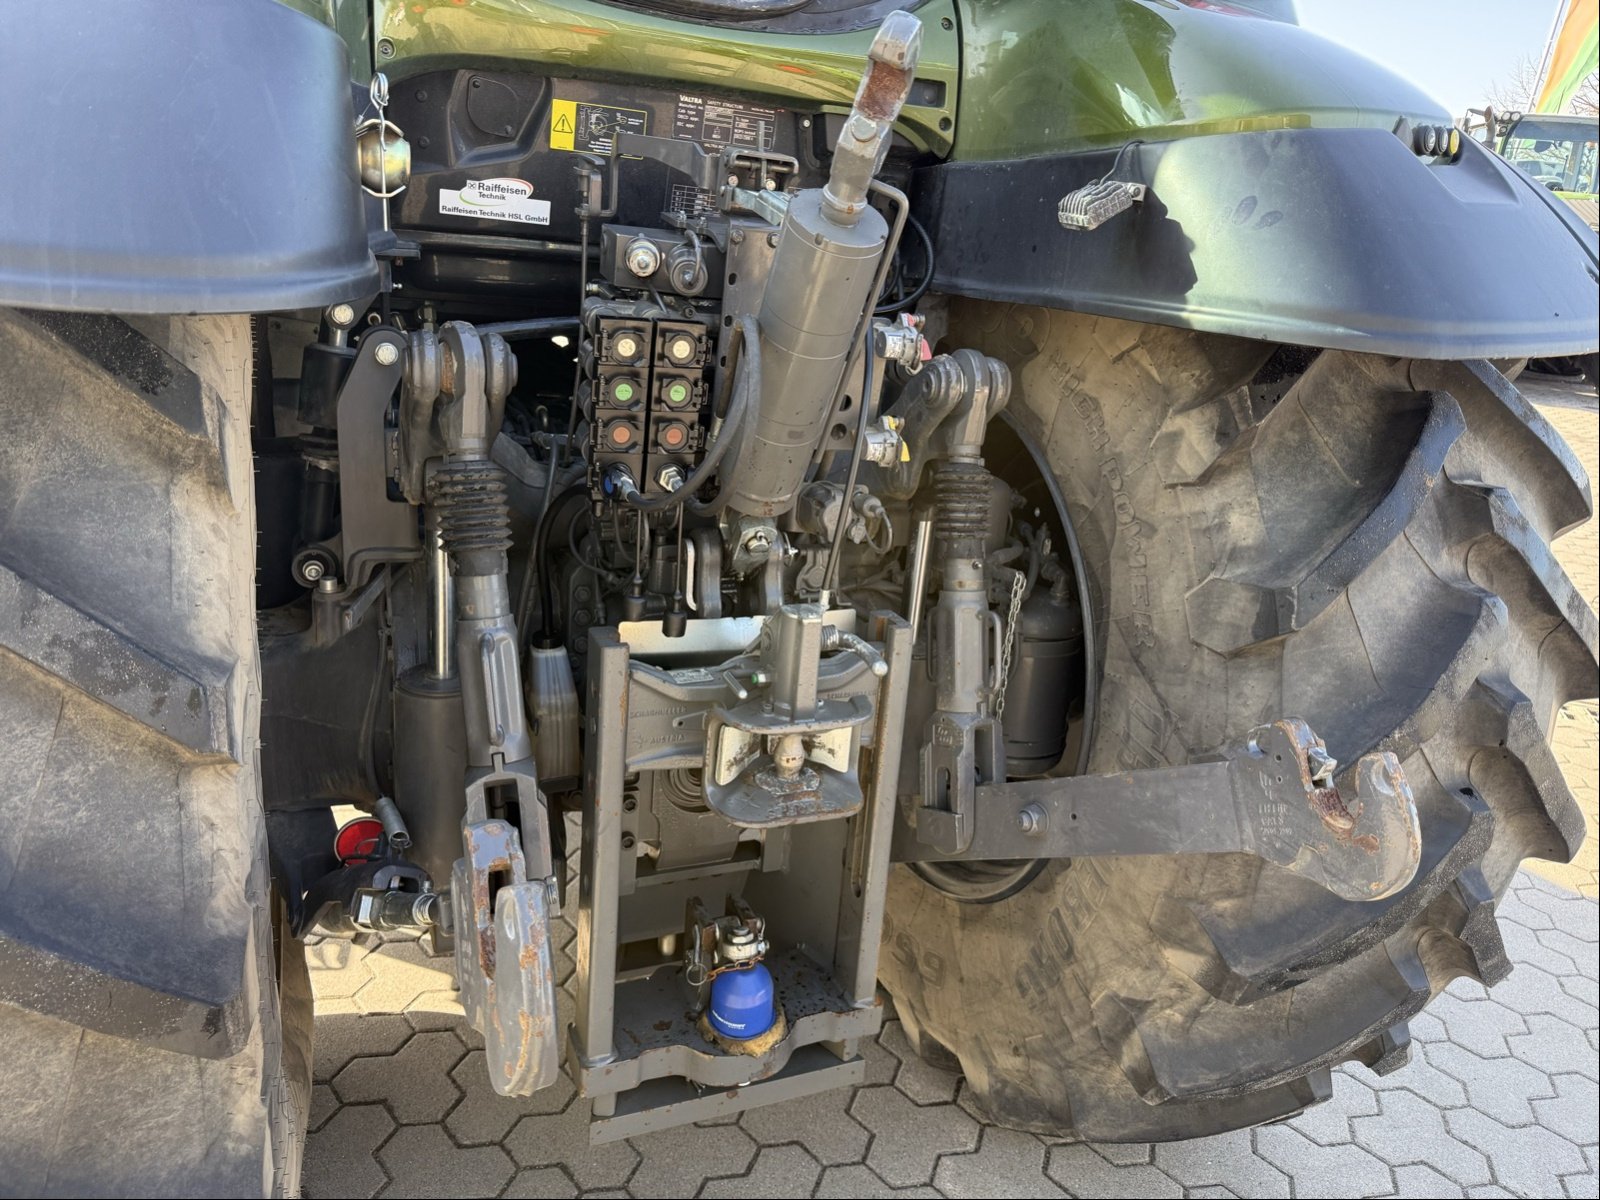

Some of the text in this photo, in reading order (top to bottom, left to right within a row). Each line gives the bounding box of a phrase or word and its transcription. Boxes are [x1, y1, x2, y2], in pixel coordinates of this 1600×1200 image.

[679, 94, 703, 104] VALTRA
[478, 182, 527, 196] Raiffeisen
[478, 192, 506, 201] Technik
[441, 205, 548, 223] Raiffeisen Technik HSL GmbH
[1099, 457, 1155, 648] POWER
